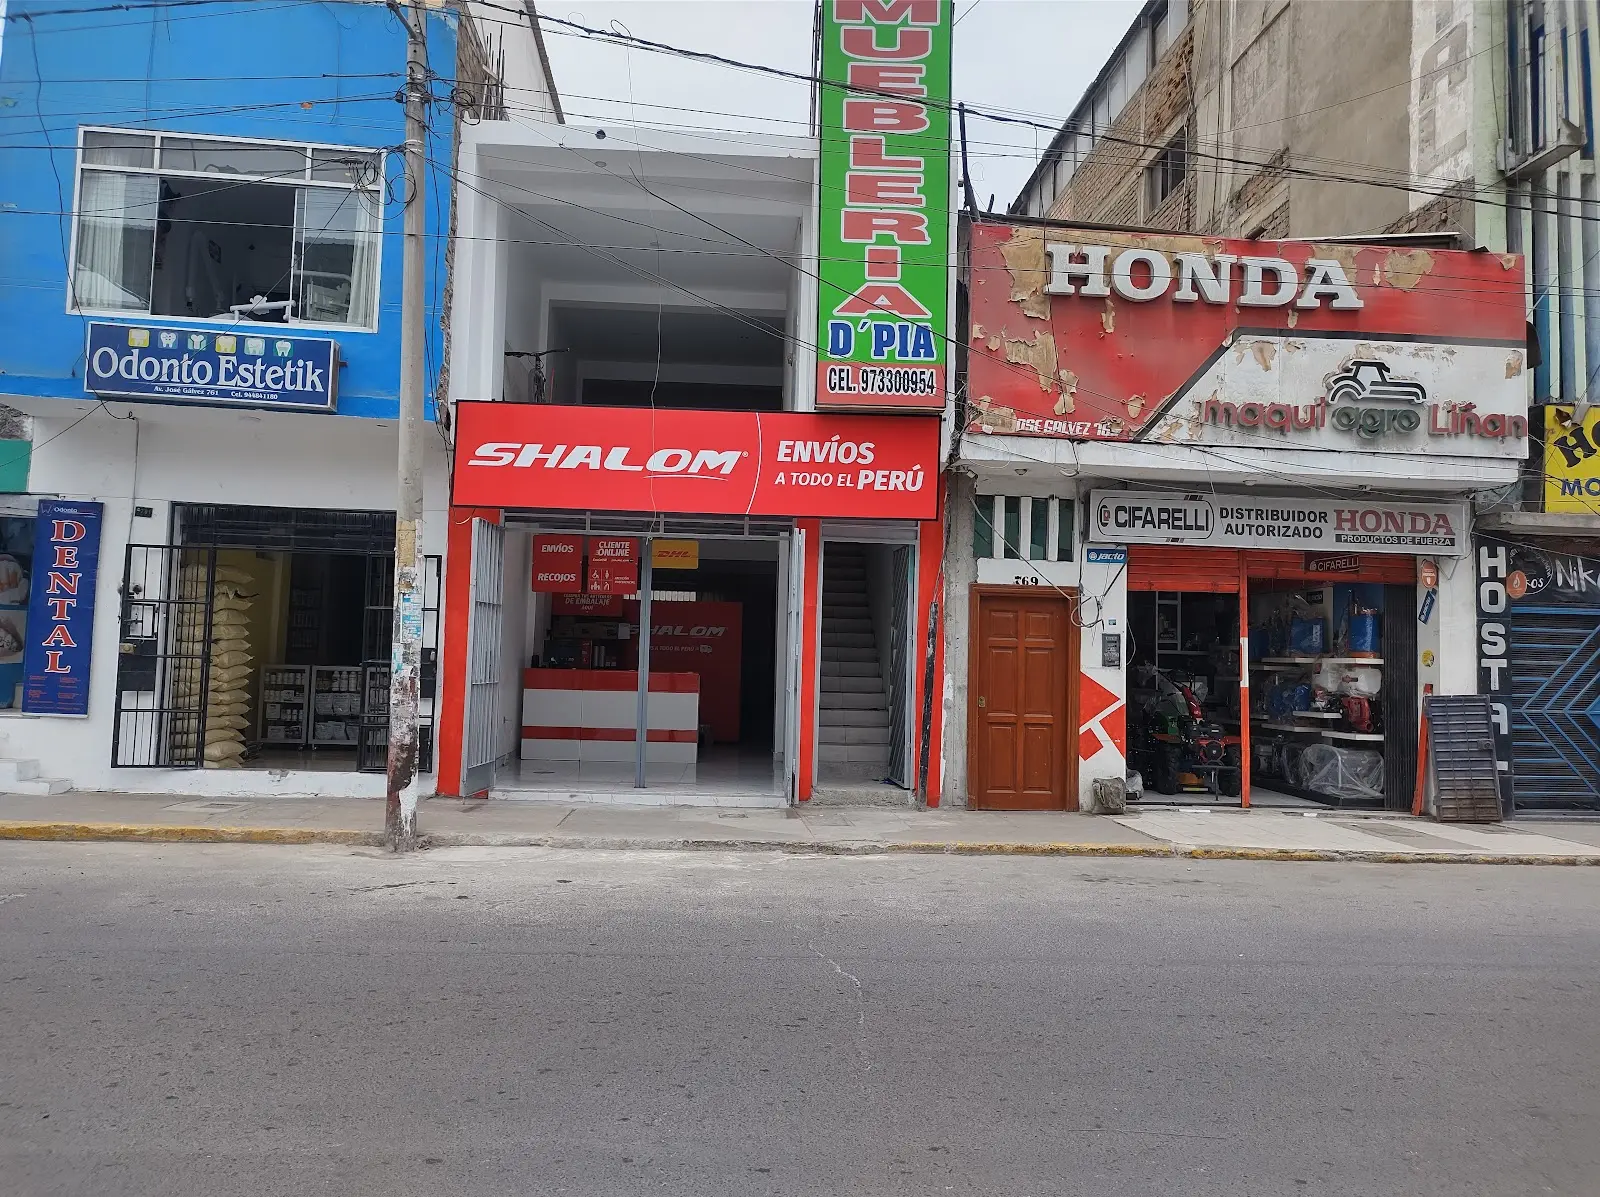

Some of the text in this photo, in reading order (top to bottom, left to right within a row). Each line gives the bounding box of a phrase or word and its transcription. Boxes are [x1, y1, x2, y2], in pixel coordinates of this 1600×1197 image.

[833, 0, 941, 318] MUEBLERIA
[1044, 243, 1364, 309] HONDA
[92, 347, 325, 393] Odonto Estetik
[828, 367, 936, 396] CEL. 973300954
[165, 386, 181, 394] José
[183, 387, 205, 395] Gálvez
[1205, 396, 1326, 432] maqui
[1331, 406, 1421, 439] agro
[467, 442, 744, 475] SHALOM
[777, 434, 875, 465] ENVÍOS
[774, 464, 924, 492] A TODO EL PERÚ
[1114, 505, 1209, 531] CIFARELLI
[1219, 506, 1328, 523] DISTRIBUIDOR
[1333, 509, 1456, 536] HONDA
[1224, 523, 1323, 539] AUTORIZADO
[1341, 534, 1452, 546] PRODUCTOS DE FUERZA
[541, 542, 574, 553] ENVÍOS
[597, 549, 630, 557] ONLINE
[599, 541, 630, 549] CLIENTE
[656, 550, 692, 558] DHL
[1096, 552, 1125, 561] jacto
[1317, 556, 1359, 571] CIFARELLI
[1554, 557, 1600, 592] Nik
[537, 573, 576, 583] RECOJOS
[42, 520, 86, 673] DENTAL
[565, 597, 610, 606] DE EMBALAJE
[1479, 546, 1508, 771] HOSTA
